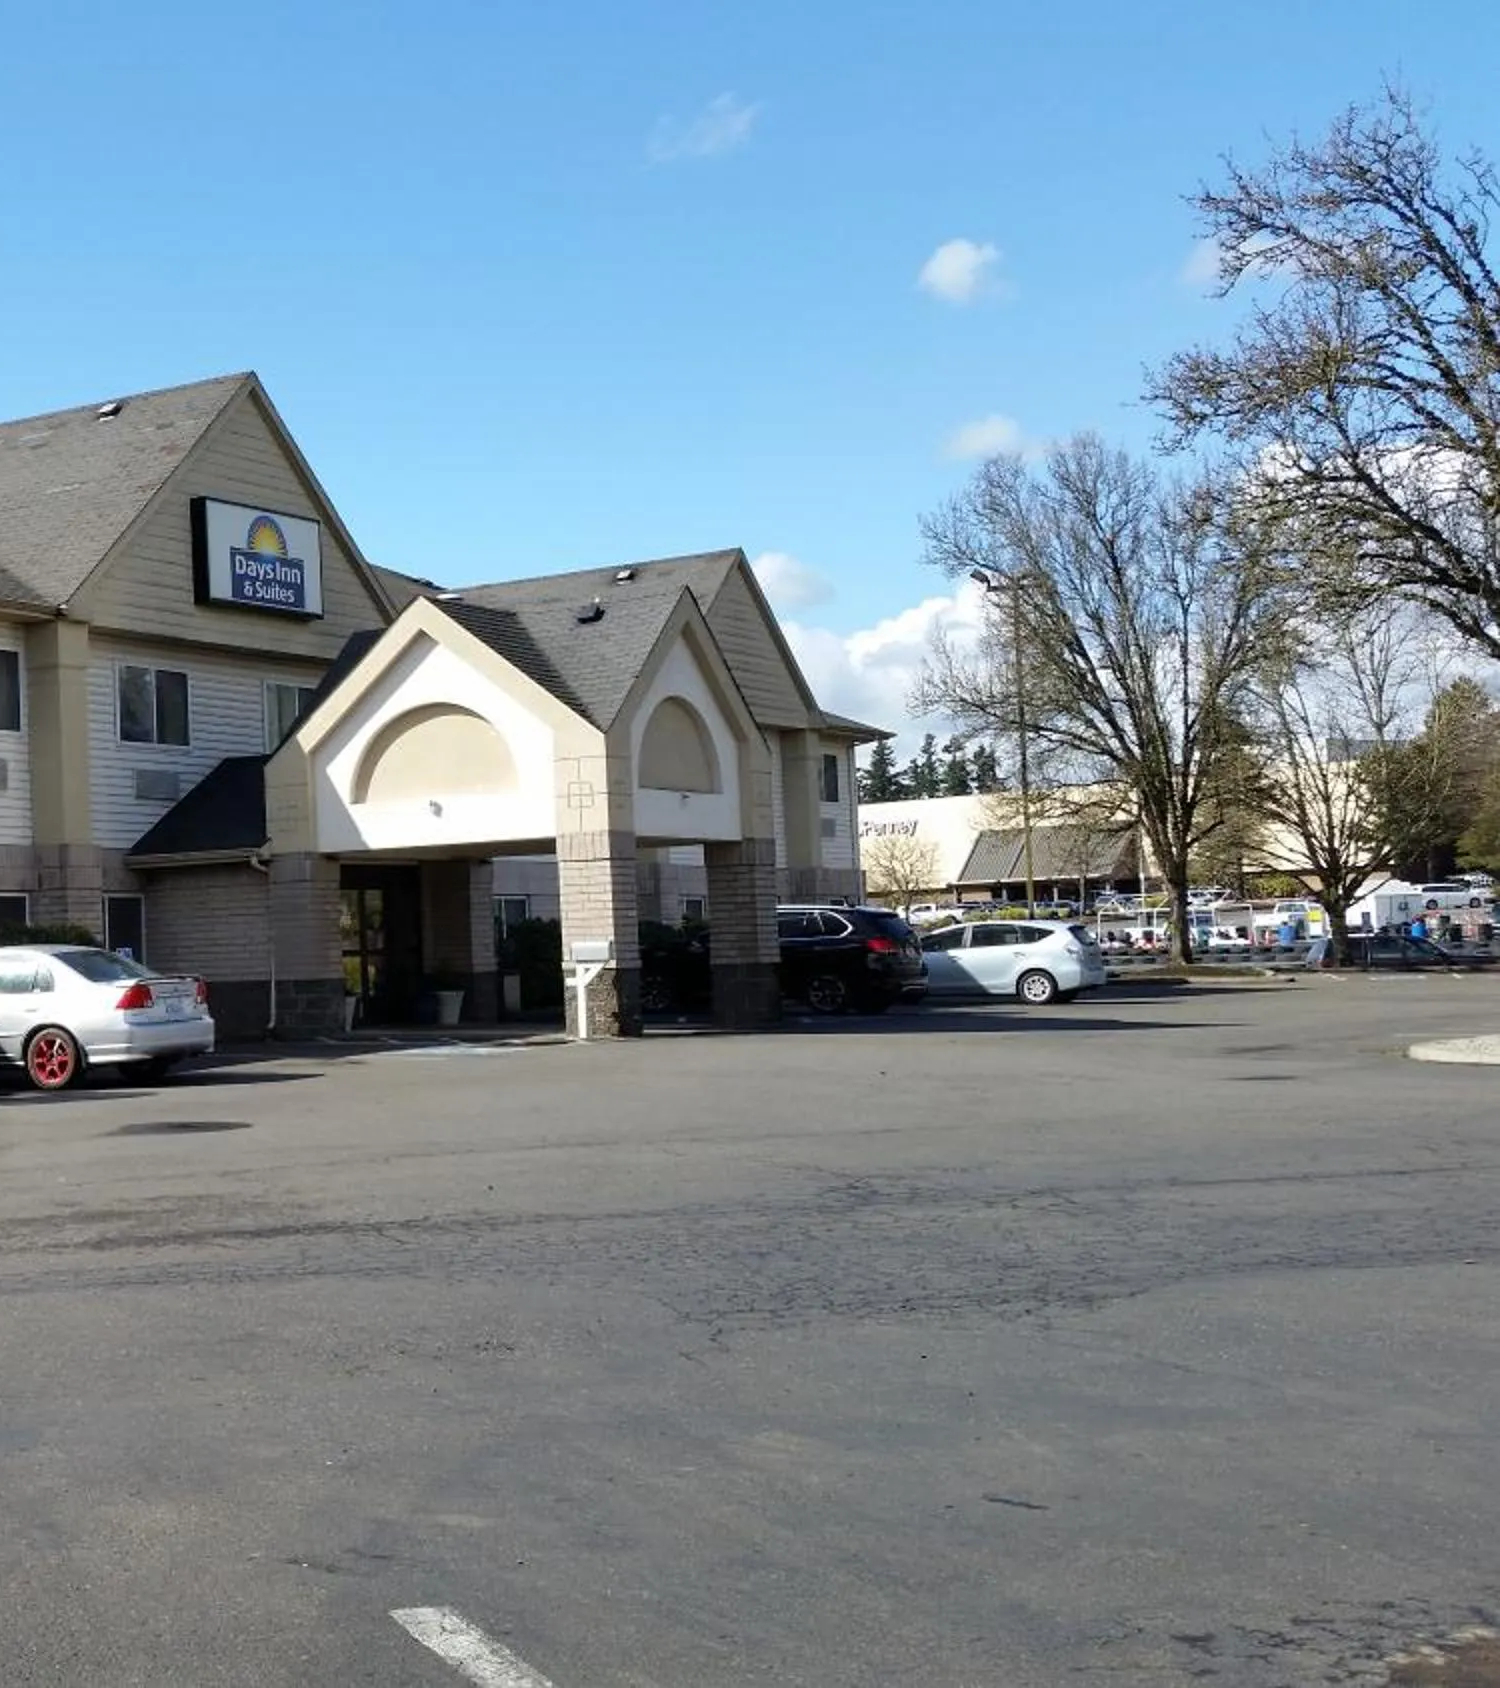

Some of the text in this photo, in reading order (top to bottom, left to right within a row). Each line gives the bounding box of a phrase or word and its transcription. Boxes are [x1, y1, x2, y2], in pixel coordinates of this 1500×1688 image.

[235, 555, 301, 584] Days Inn
[243, 581, 295, 603] & Suites
